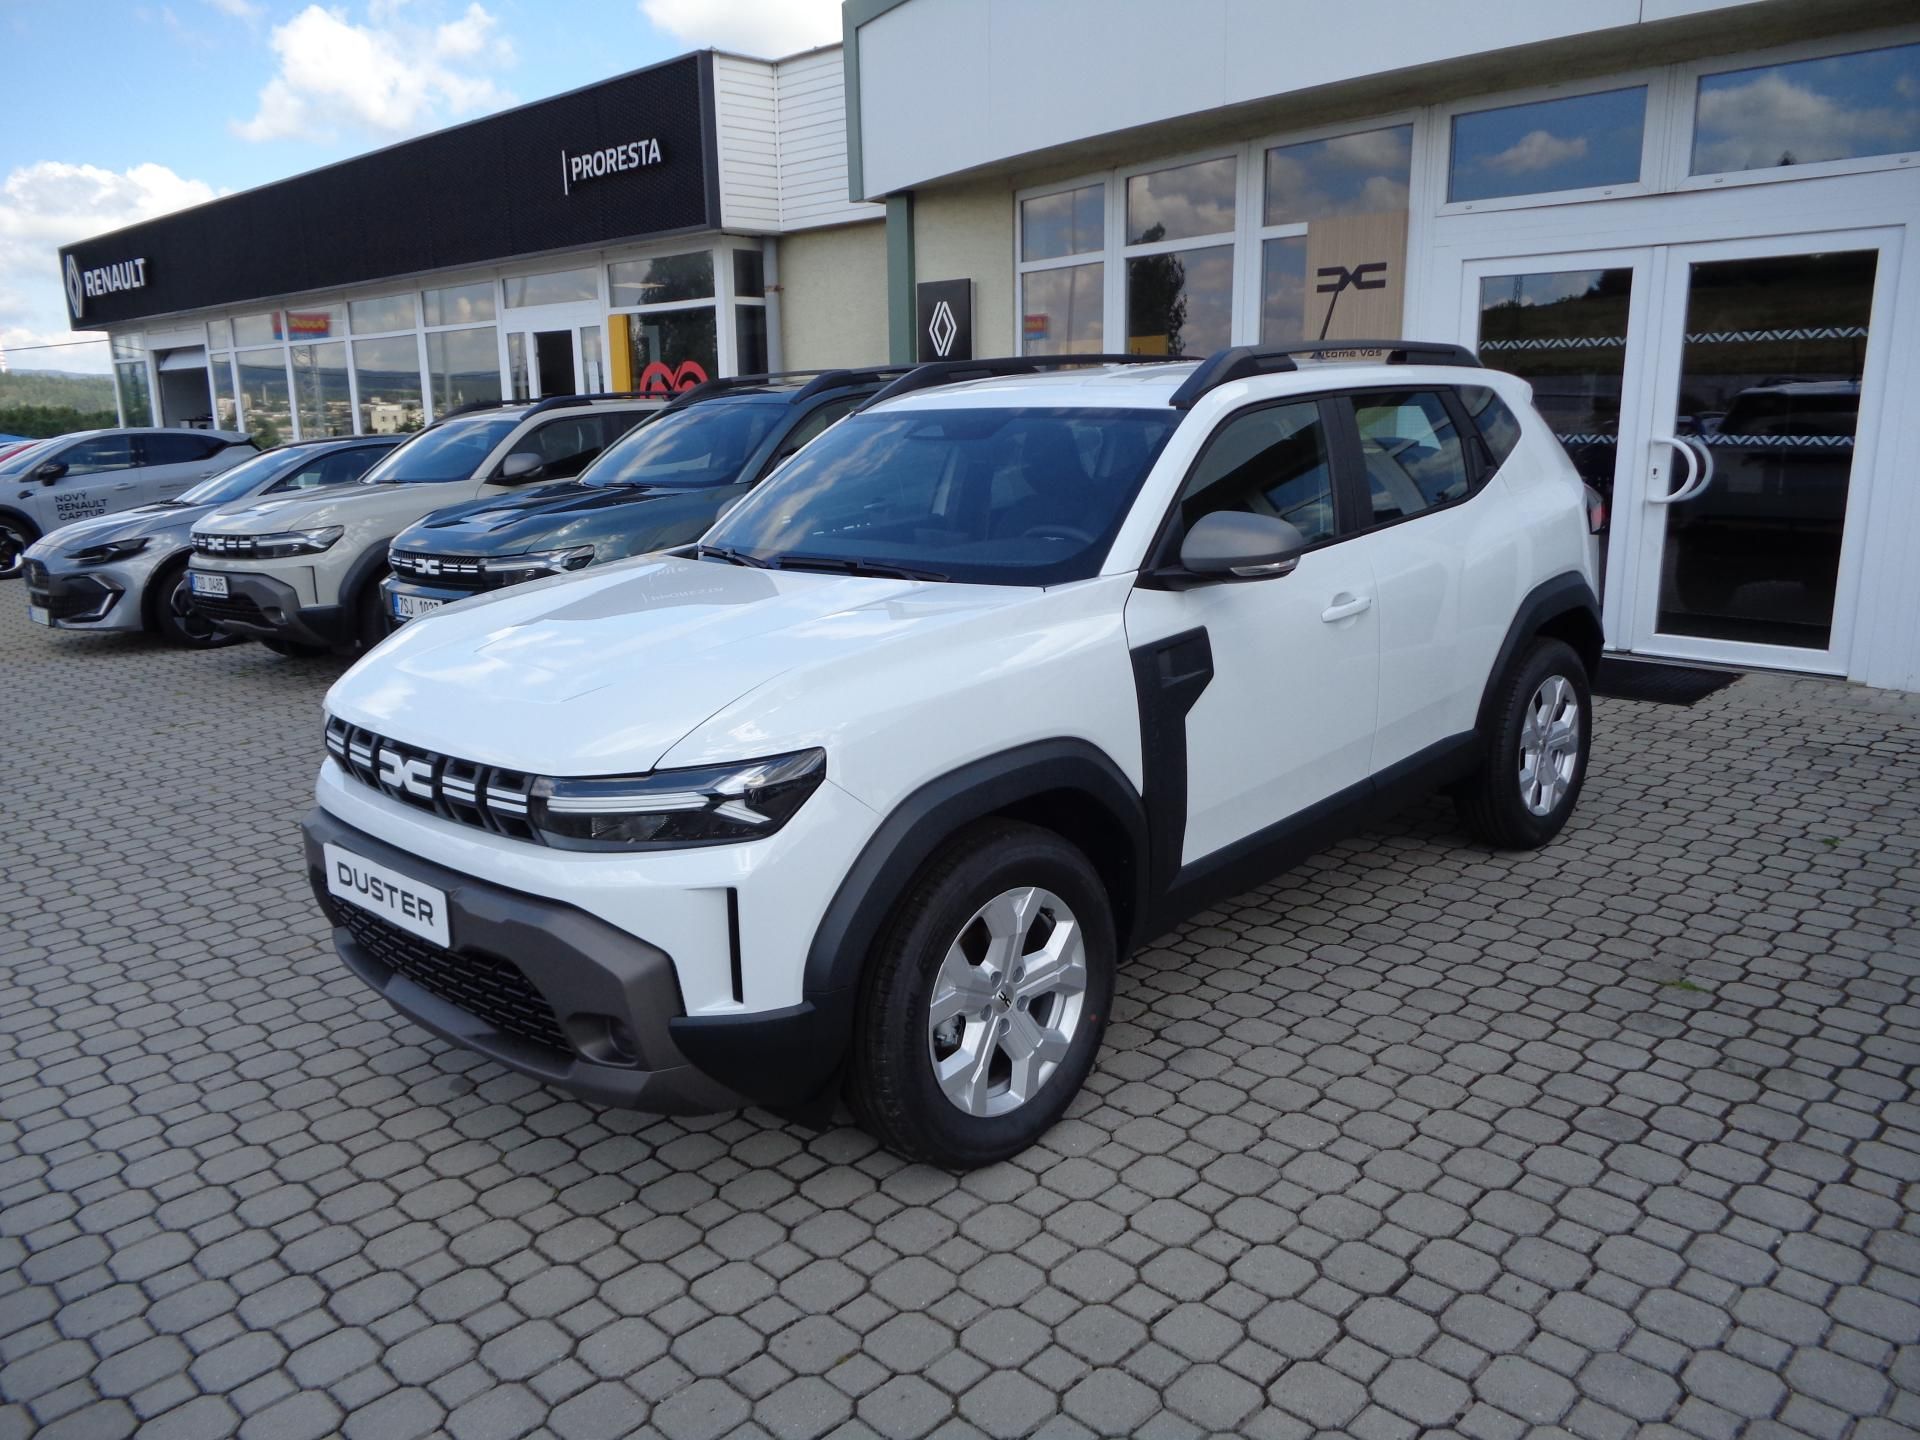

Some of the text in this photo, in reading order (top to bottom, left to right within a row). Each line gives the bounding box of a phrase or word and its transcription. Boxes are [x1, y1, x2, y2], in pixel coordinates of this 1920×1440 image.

[571, 138, 662, 182] PRORESTA
[83, 258, 146, 297] RENAULT
[55, 491, 87, 503] NOVÝ
[56, 499, 108, 512] RENAULT
[400, 597, 413, 615] 7SJ
[337, 861, 434, 926] DUSTER
